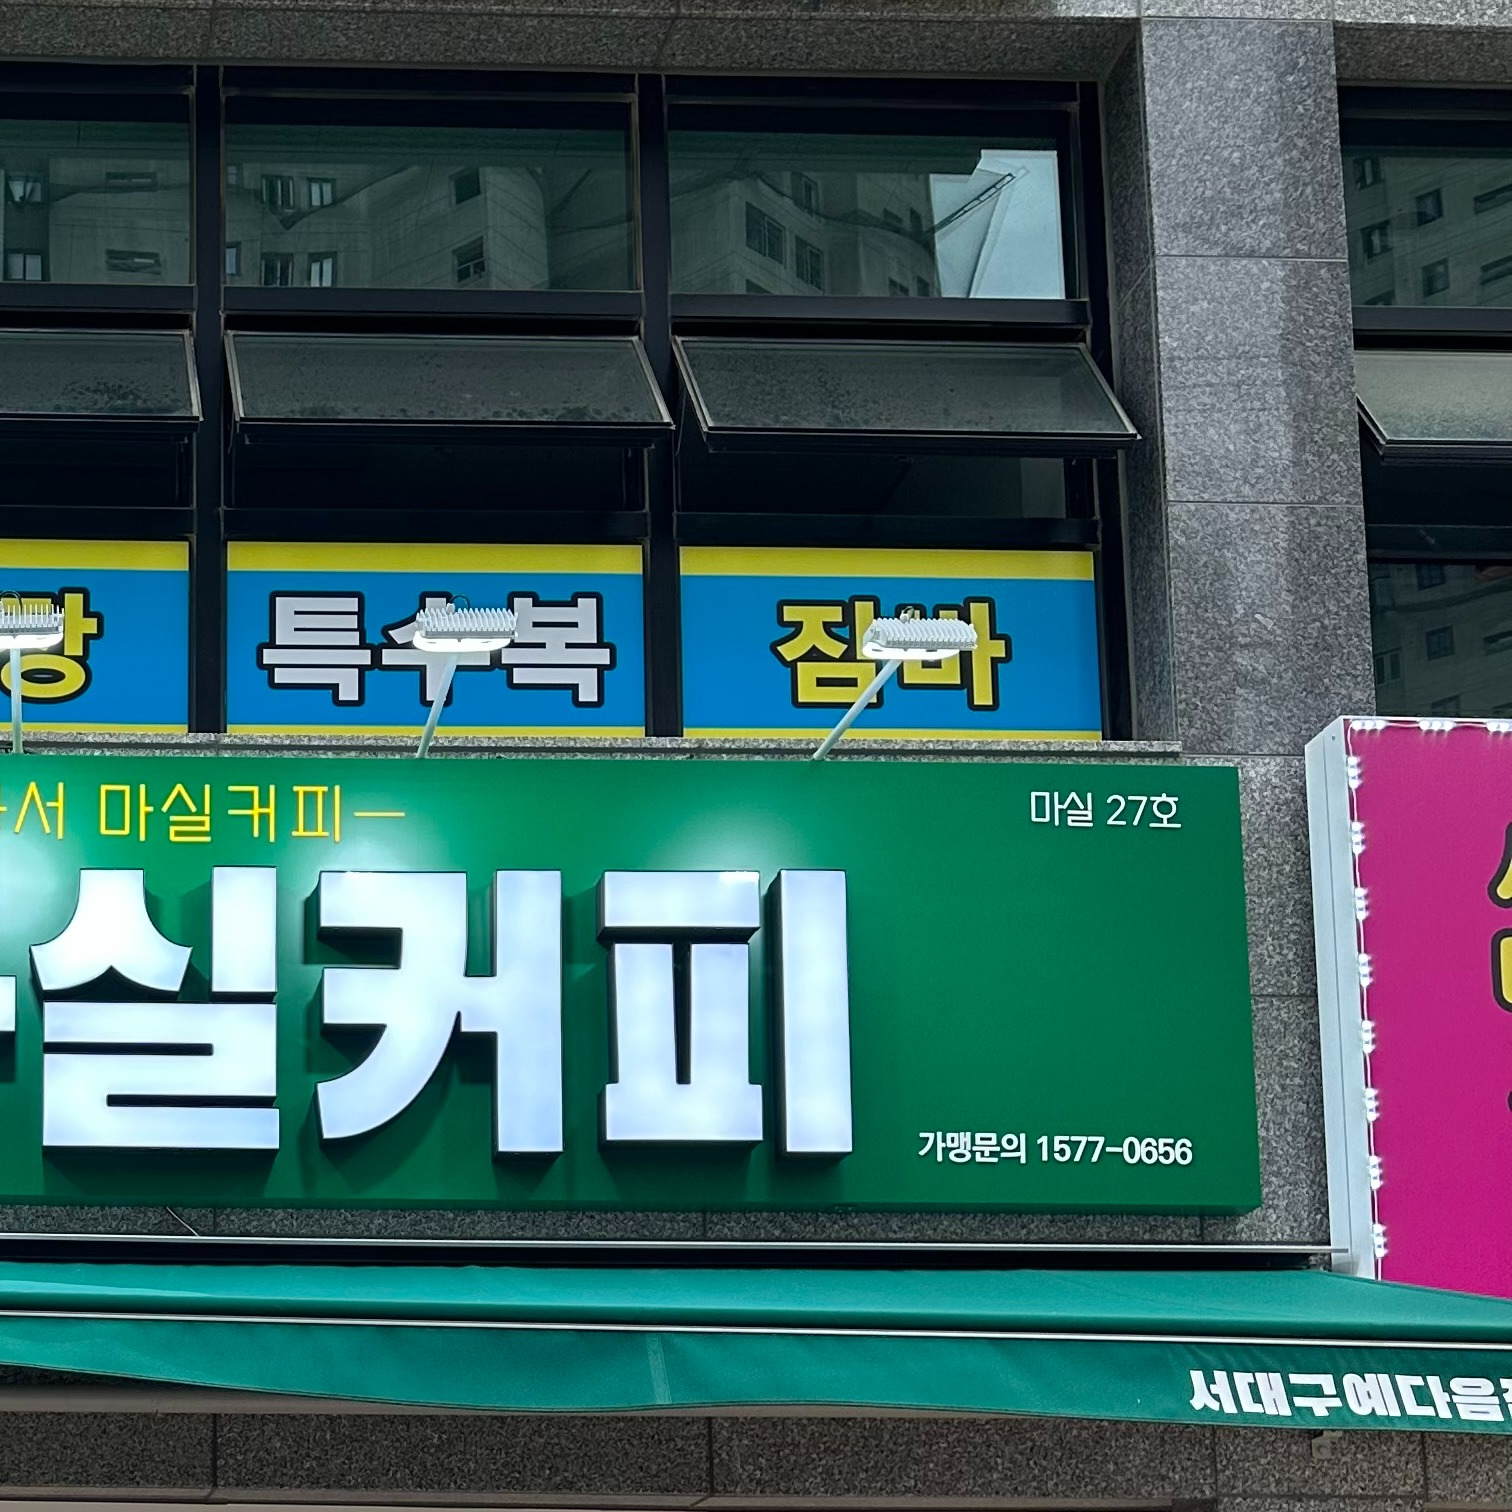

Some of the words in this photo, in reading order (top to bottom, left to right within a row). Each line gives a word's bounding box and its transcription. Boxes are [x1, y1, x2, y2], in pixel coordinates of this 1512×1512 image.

[1030, 790, 1093, 828] 마실
[1106, 791, 1183, 829] 27호
[918, 1130, 1026, 1166] 가맹문의
[1035, 1134, 1193, 1167] 1577-0656
